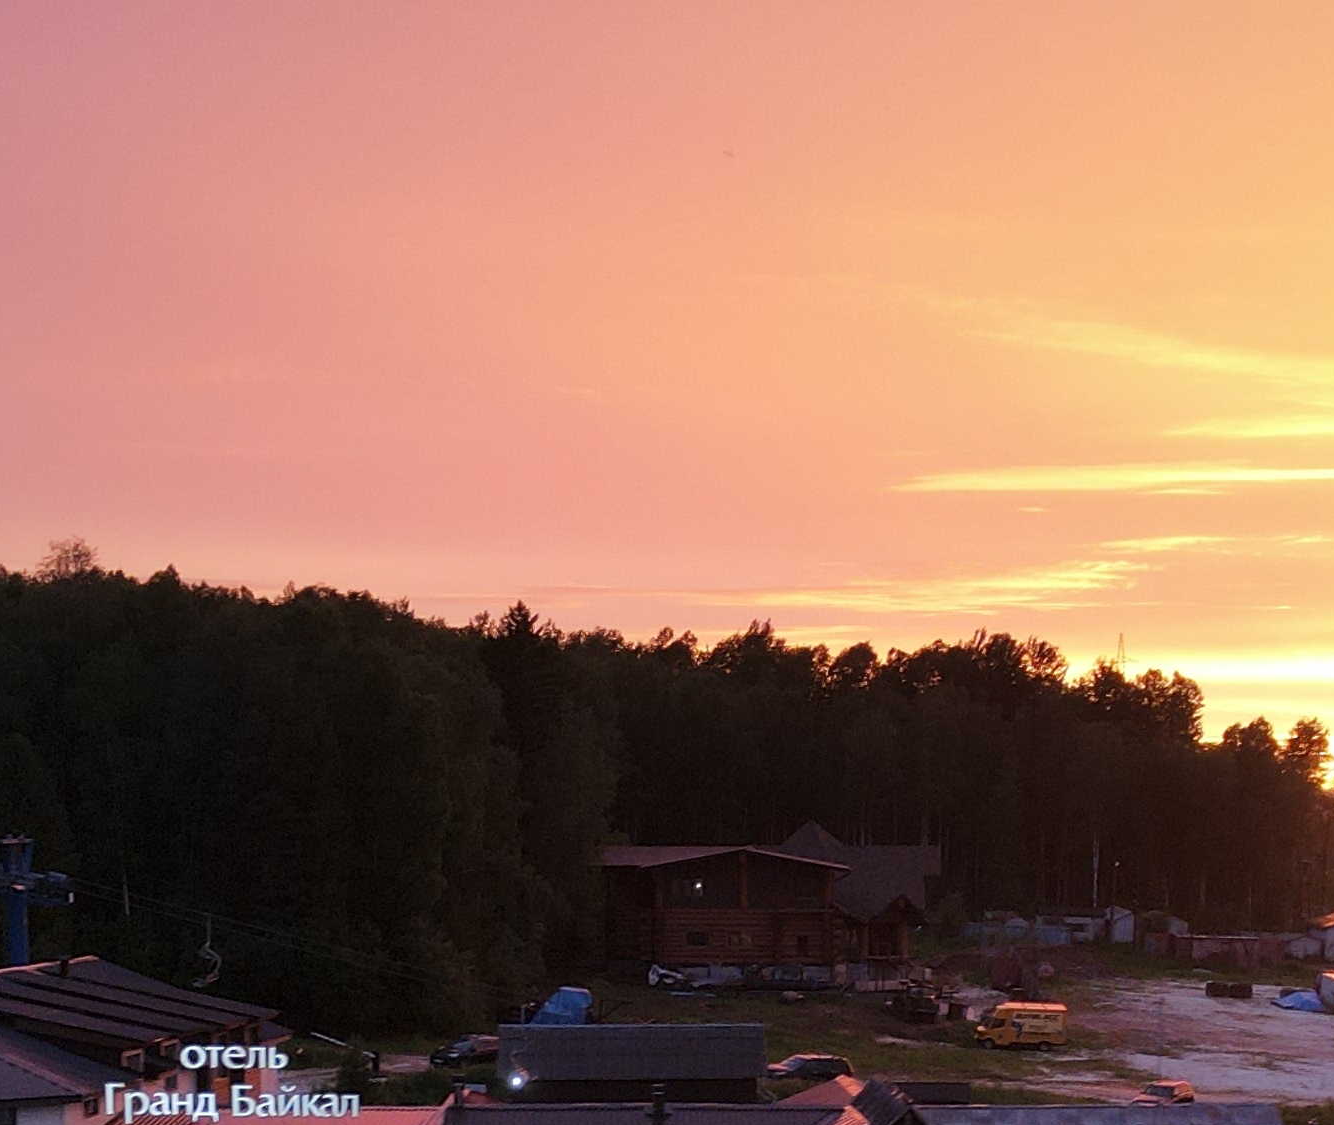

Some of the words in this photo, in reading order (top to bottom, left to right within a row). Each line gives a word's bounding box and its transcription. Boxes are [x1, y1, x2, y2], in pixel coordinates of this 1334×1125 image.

[180, 1044, 289, 1069] отель
[104, 1083, 219, 1124] Гранд
[231, 1084, 360, 1117] Байкал
